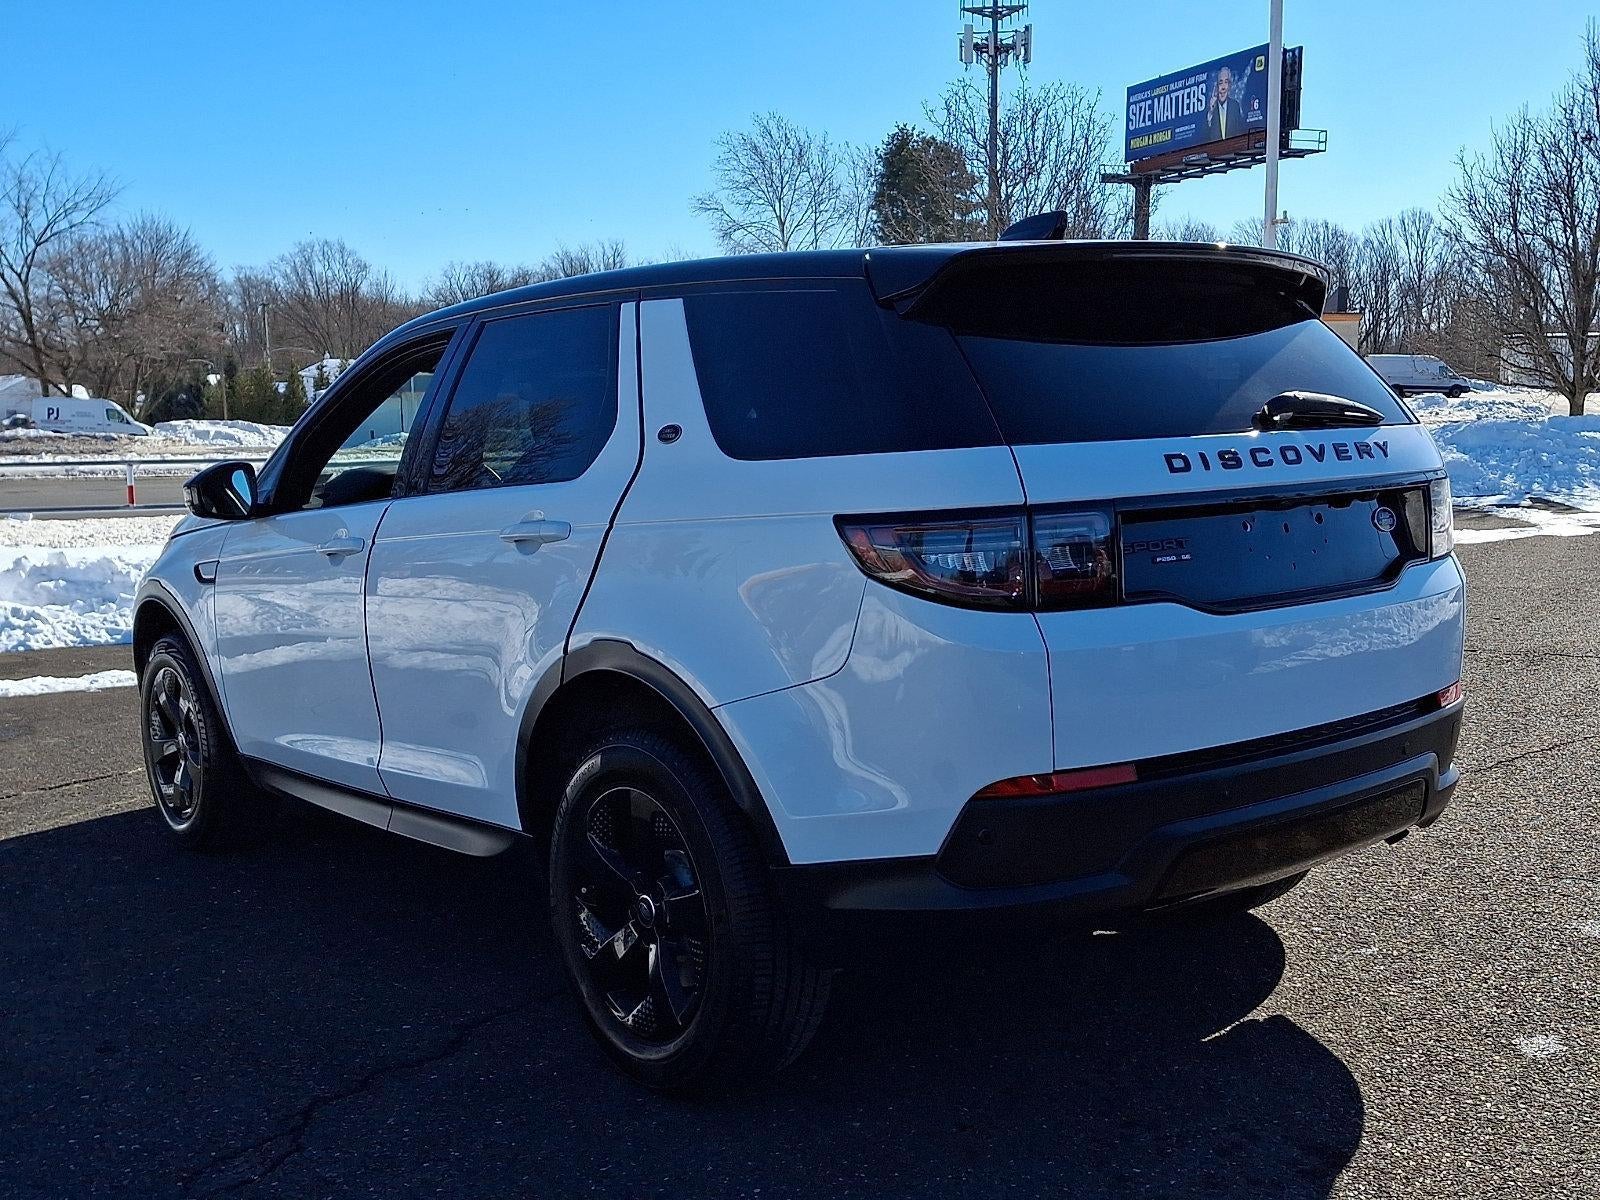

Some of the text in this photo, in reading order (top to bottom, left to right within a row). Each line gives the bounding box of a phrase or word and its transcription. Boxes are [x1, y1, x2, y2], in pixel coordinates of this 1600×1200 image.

[1151, 85, 1169, 97] LARGEST
[1186, 76, 1196, 87] LAW
[1196, 72, 1208, 84] FIRM
[1129, 83, 1207, 131] SIZE MATTERS
[1130, 136, 1149, 150] MORGAN
[1149, 134, 1153, 145] &
[1153, 129, 1172, 144] MORGAN
[47, 407, 60, 420] PJ
[1163, 440, 1389, 474] DISCOVERY
[1123, 538, 1191, 554] SPORT
